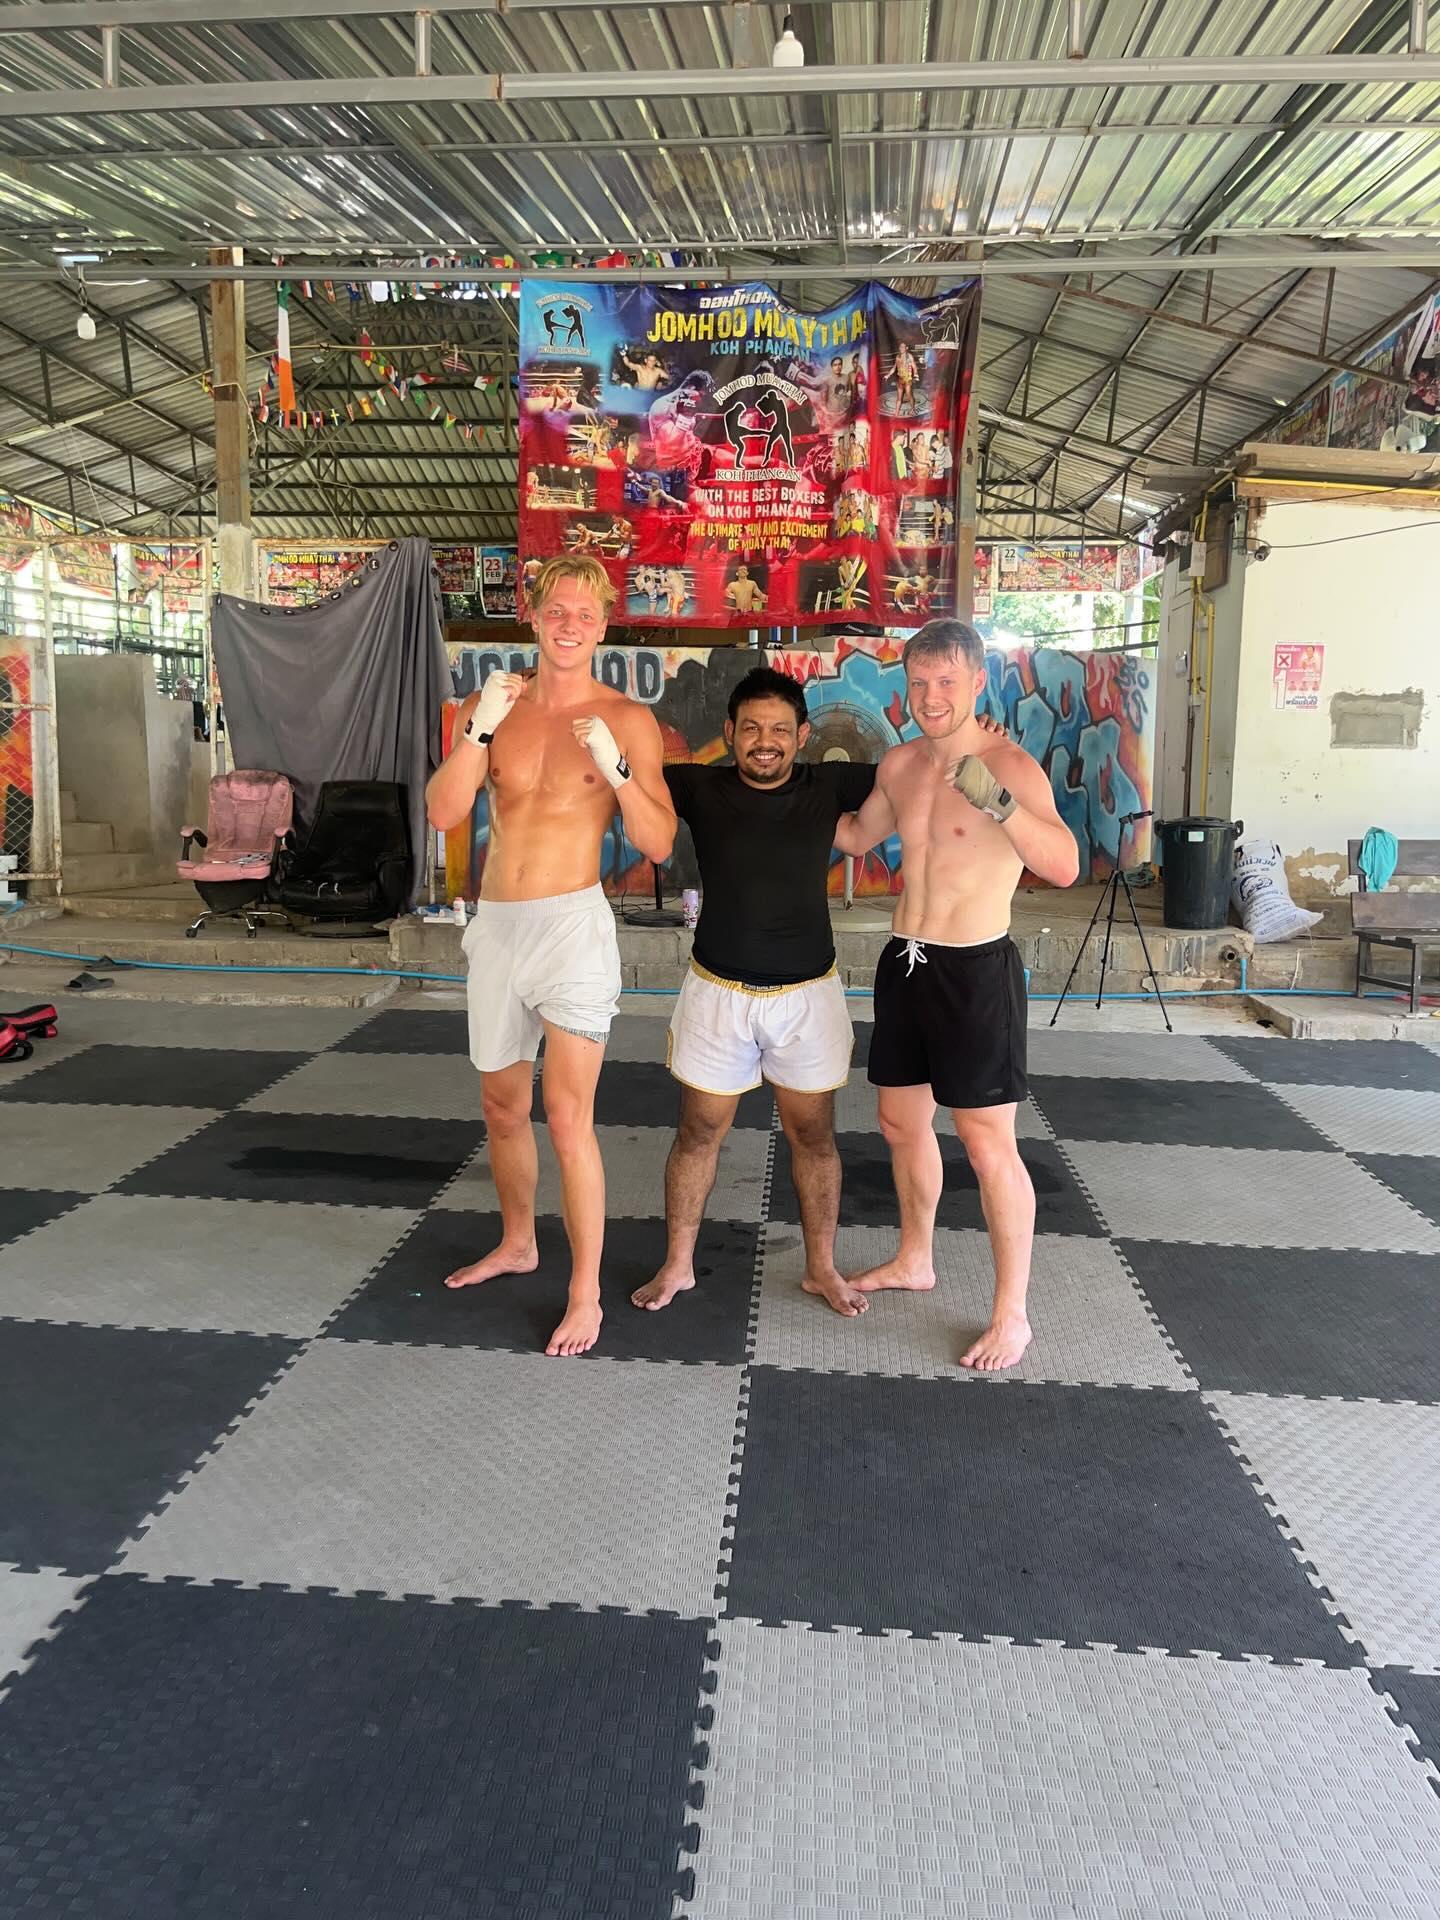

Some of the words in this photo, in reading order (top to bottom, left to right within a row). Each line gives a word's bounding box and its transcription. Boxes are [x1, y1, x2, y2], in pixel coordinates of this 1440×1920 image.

[646, 309, 748, 343] JOMHOD
[710, 340, 739, 355] KOH
[745, 340, 812, 363] PHANGAN
[712, 374, 757, 406] JOMHOD
[756, 372, 808, 406] MUAYTHAI
[715, 469, 743, 481] KOH
[744, 468, 802, 482] PHANGAN
[695, 488, 723, 503] WITH
[727, 489, 750, 503] THE
[752, 487, 778, 503] BEST
[780, 486, 825, 505] BOXERS
[708, 503, 724, 518] ON
[726, 505, 751, 518] KOH
[755, 503, 812, 520] PHANGAN
[690, 522, 706, 537] THE
[763, 520, 778, 536] AND
[780, 521, 829, 539] EXCITEMENT
[728, 538, 740, 551] OF
[741, 538, 767, 550] MUAY
[1005, 549, 1016, 558] 22
[485, 560, 500, 571] 23
